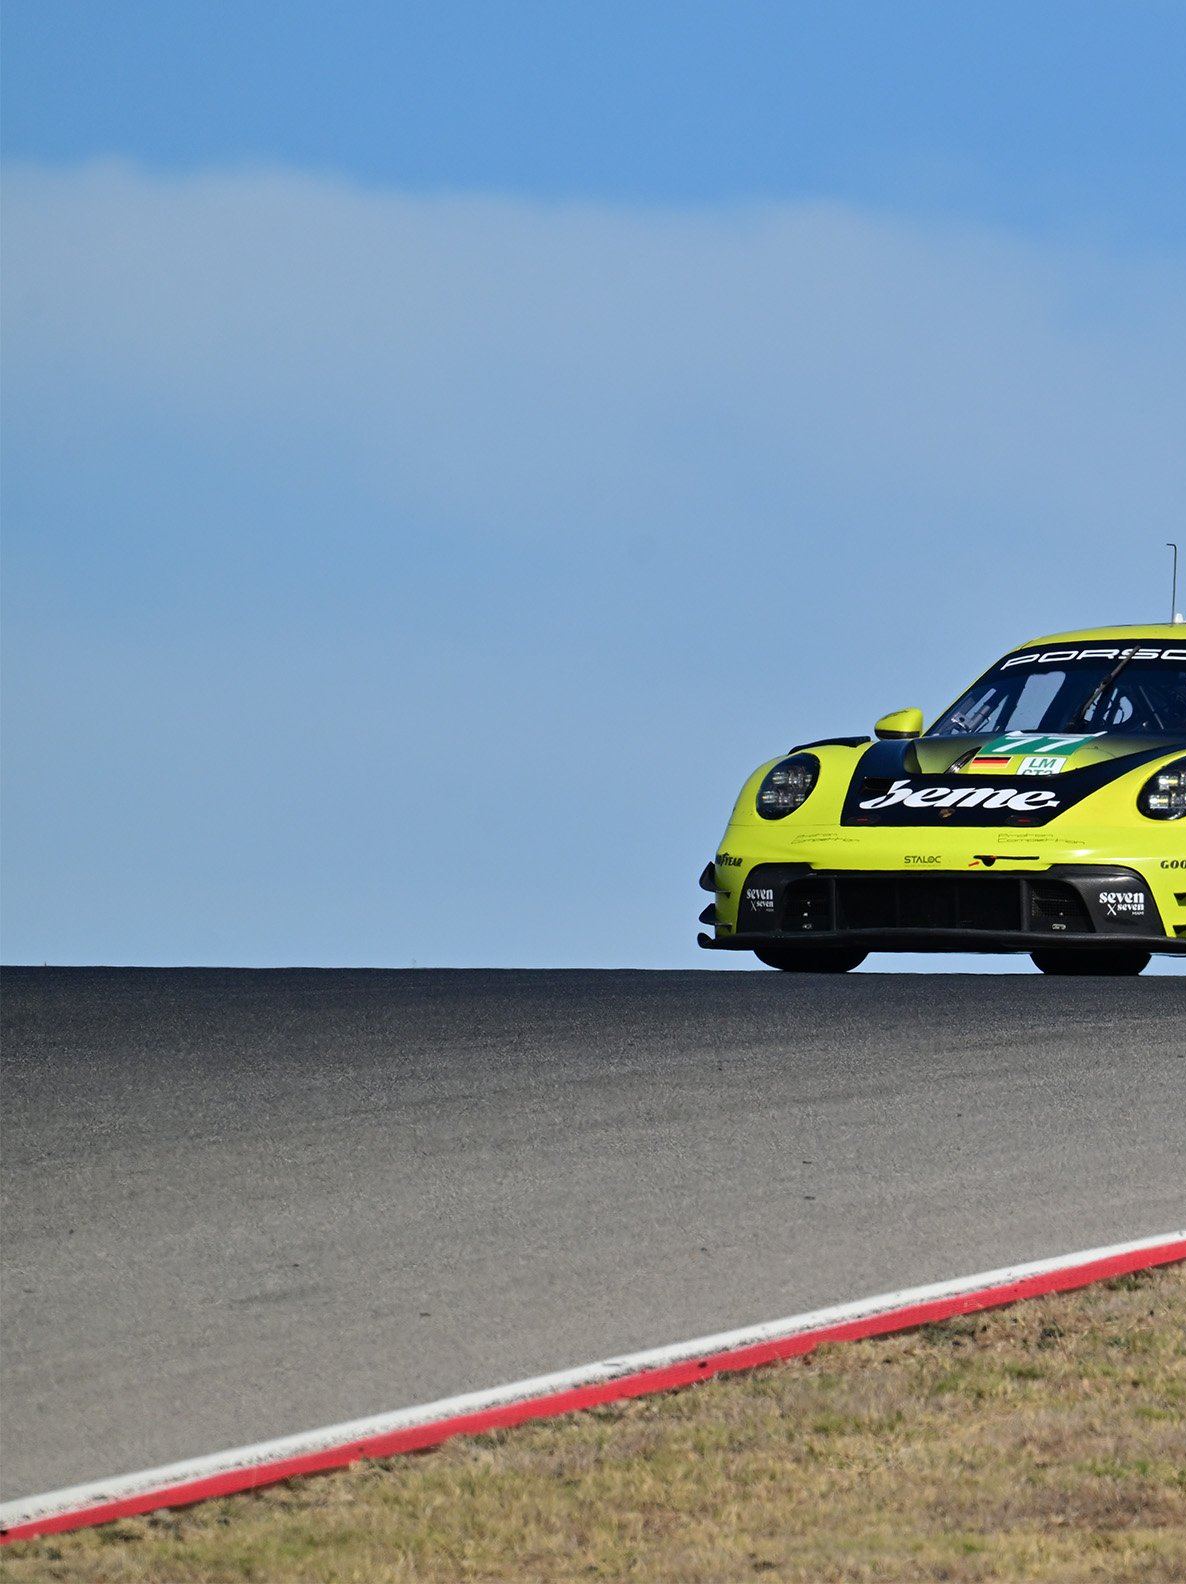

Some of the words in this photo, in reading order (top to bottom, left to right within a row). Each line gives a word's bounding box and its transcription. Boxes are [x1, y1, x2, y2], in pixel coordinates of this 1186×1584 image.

[991, 735, 1085, 753] 77
[1028, 758, 1057, 768] LM
[904, 856, 941, 864] STALOC
[746, 889, 773, 900] seven
[1099, 892, 1145, 903] seven
